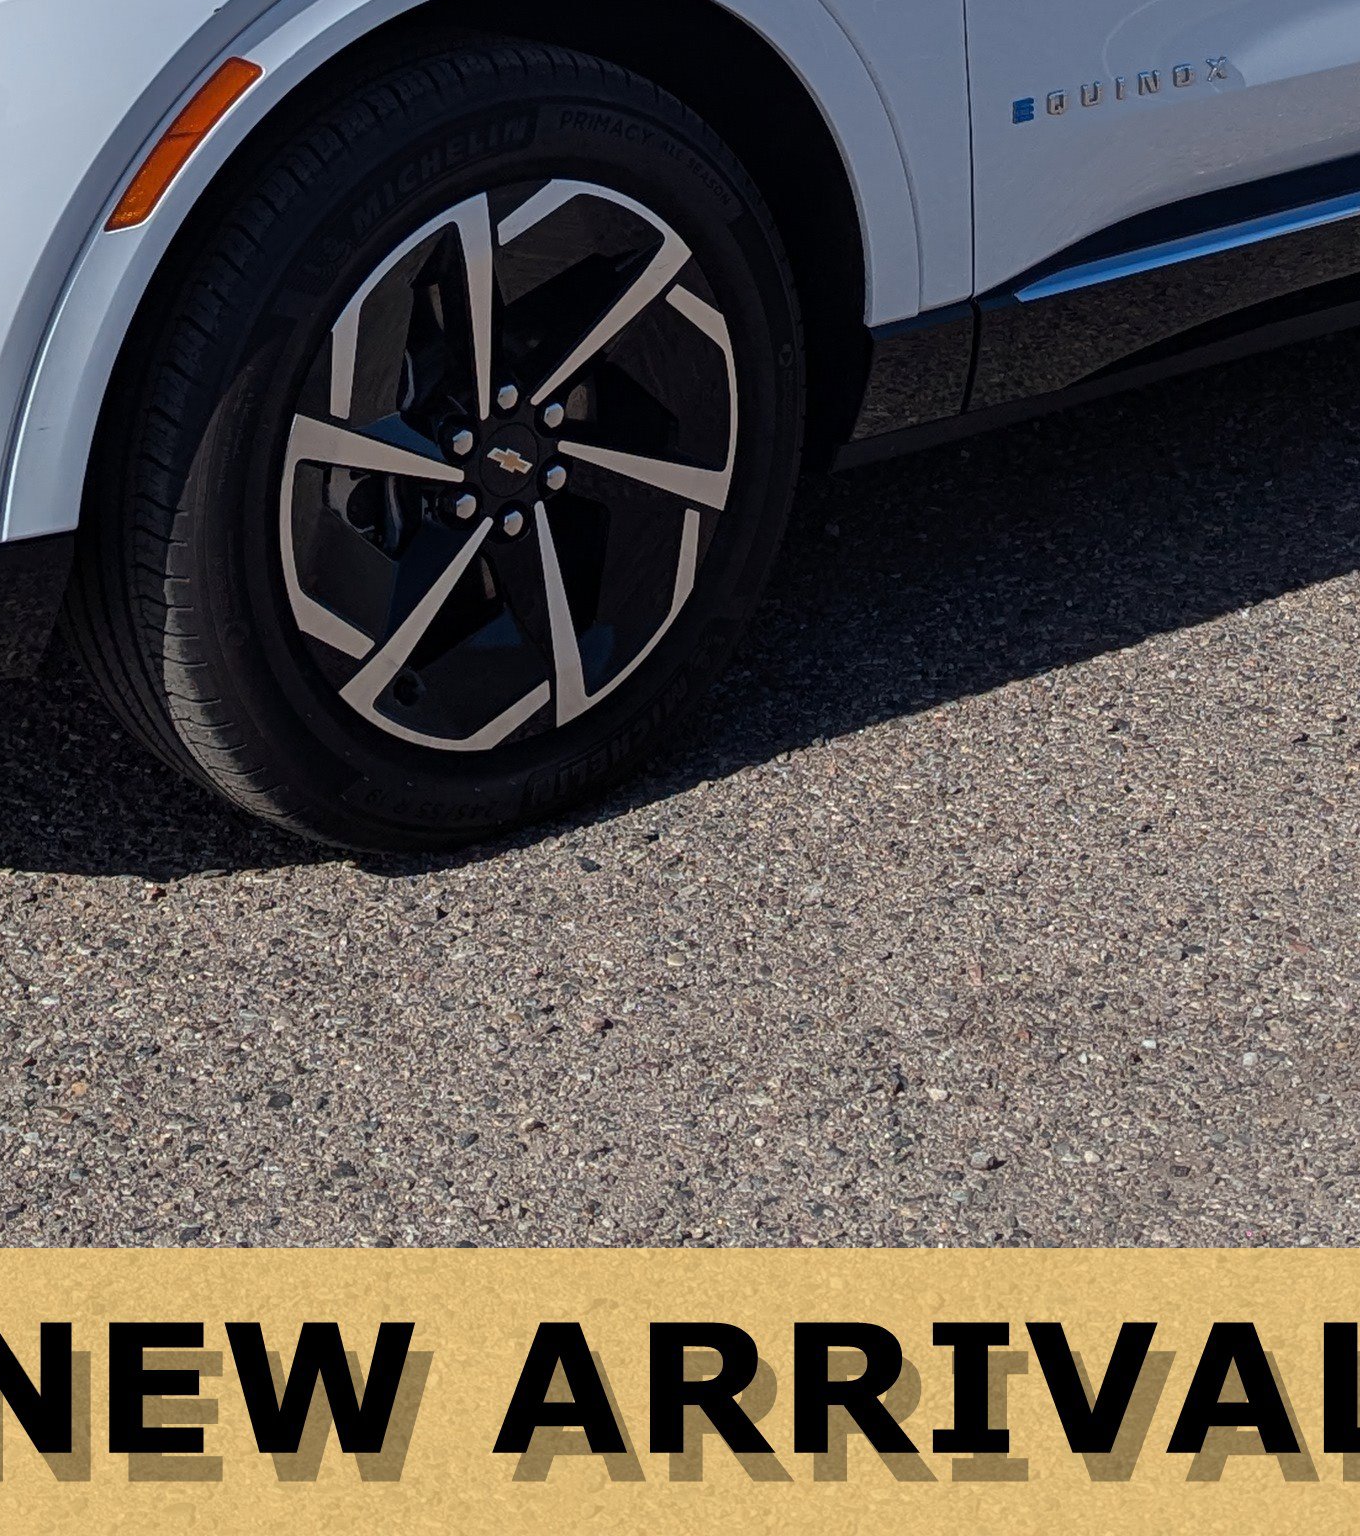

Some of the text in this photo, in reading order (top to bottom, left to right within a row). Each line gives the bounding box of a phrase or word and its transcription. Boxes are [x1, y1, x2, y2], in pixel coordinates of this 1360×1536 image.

[1011, 55, 1228, 125] EQUINOX
[350, 112, 532, 236] MICHELIN
[557, 109, 654, 145] PRIMACY
